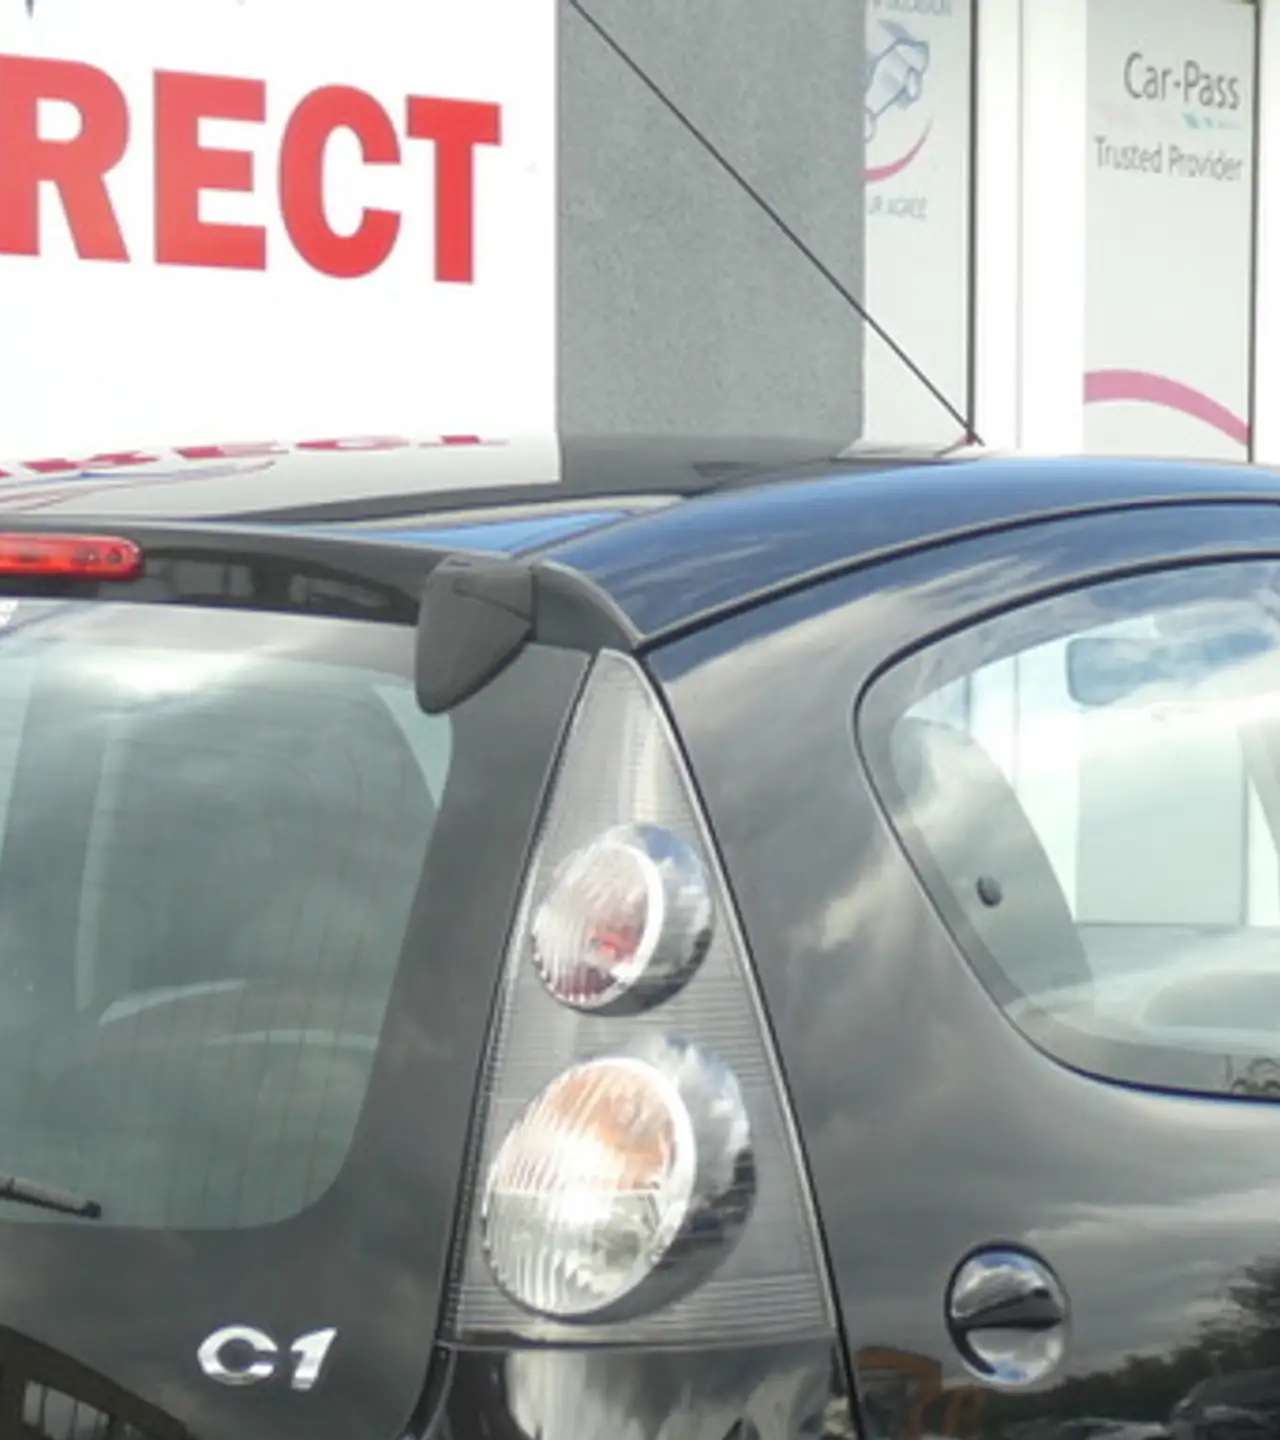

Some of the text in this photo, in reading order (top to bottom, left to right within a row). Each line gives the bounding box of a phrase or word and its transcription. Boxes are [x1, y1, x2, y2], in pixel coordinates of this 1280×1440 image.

[1123, 51, 1240, 110] Car-Pass
[1095, 135, 1244, 181] Trusted Provider
[197, 1325, 338, 1390] C1
